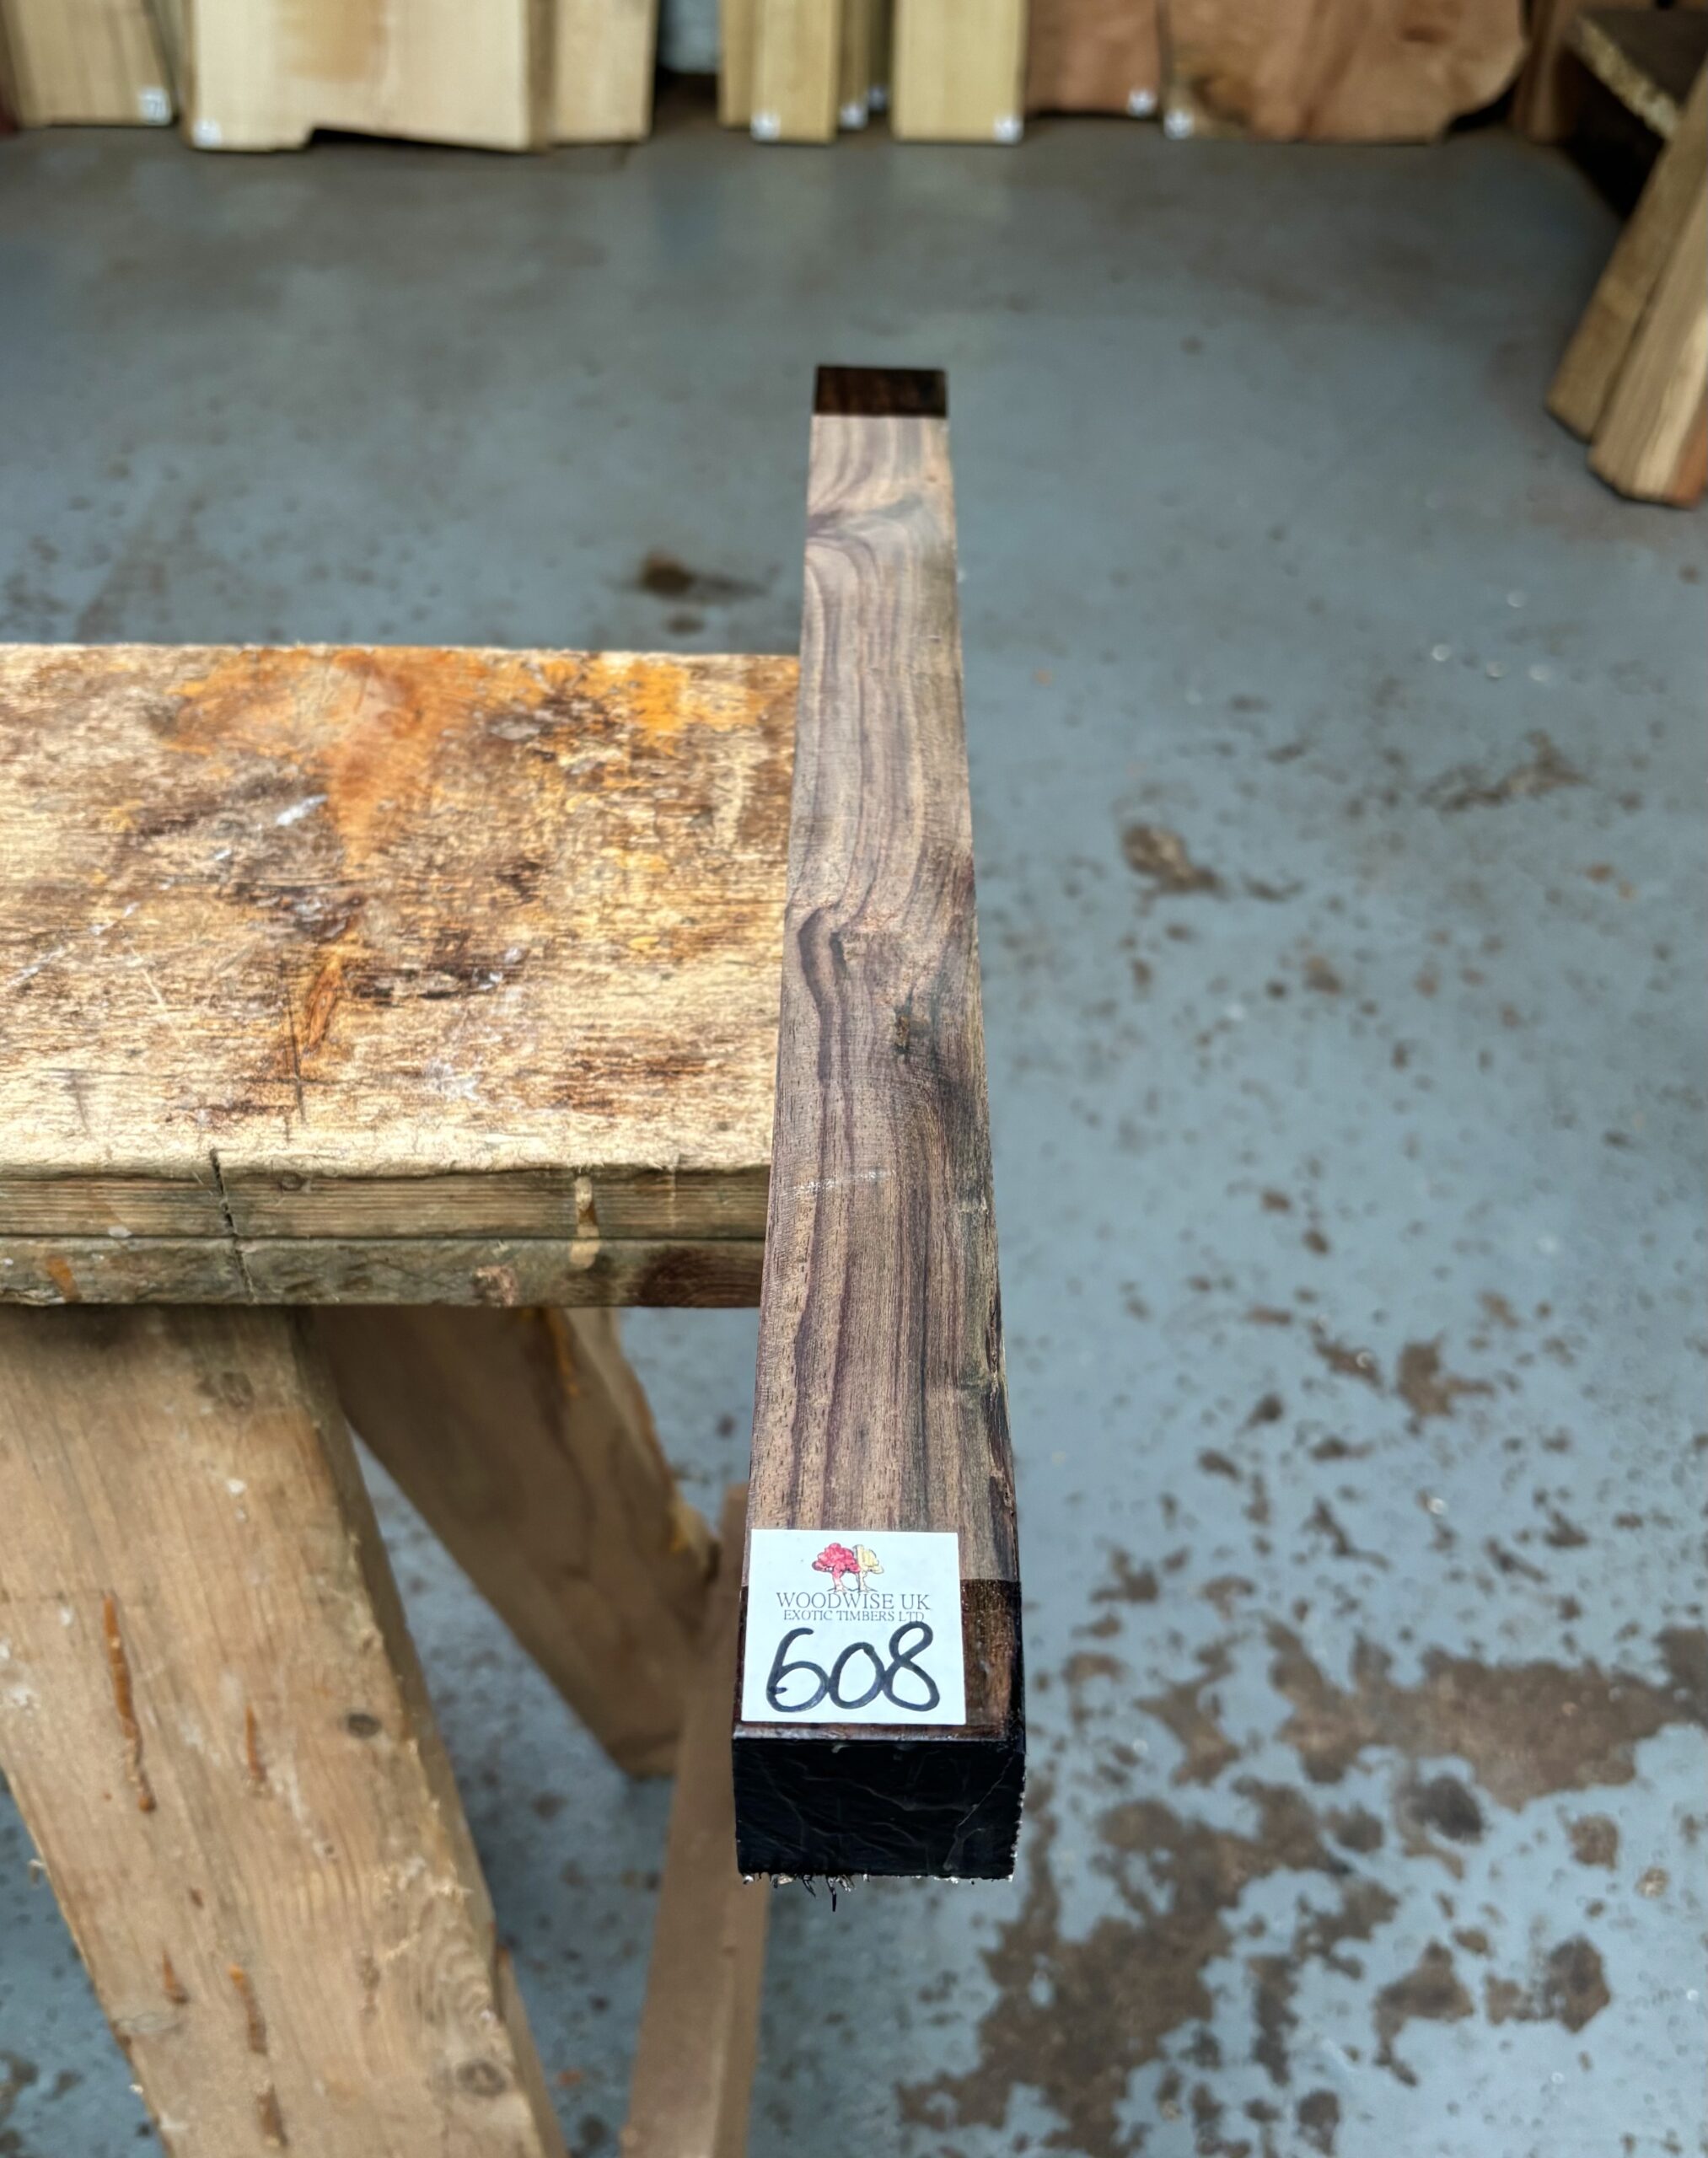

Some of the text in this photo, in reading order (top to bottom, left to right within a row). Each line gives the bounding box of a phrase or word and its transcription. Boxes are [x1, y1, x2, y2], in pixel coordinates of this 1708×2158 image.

[776, 1592, 932, 1611] WOODWISE UK
[783, 1610, 925, 1623] EXOTIC TIMBERS LTD
[766, 1621, 940, 1712] 608
